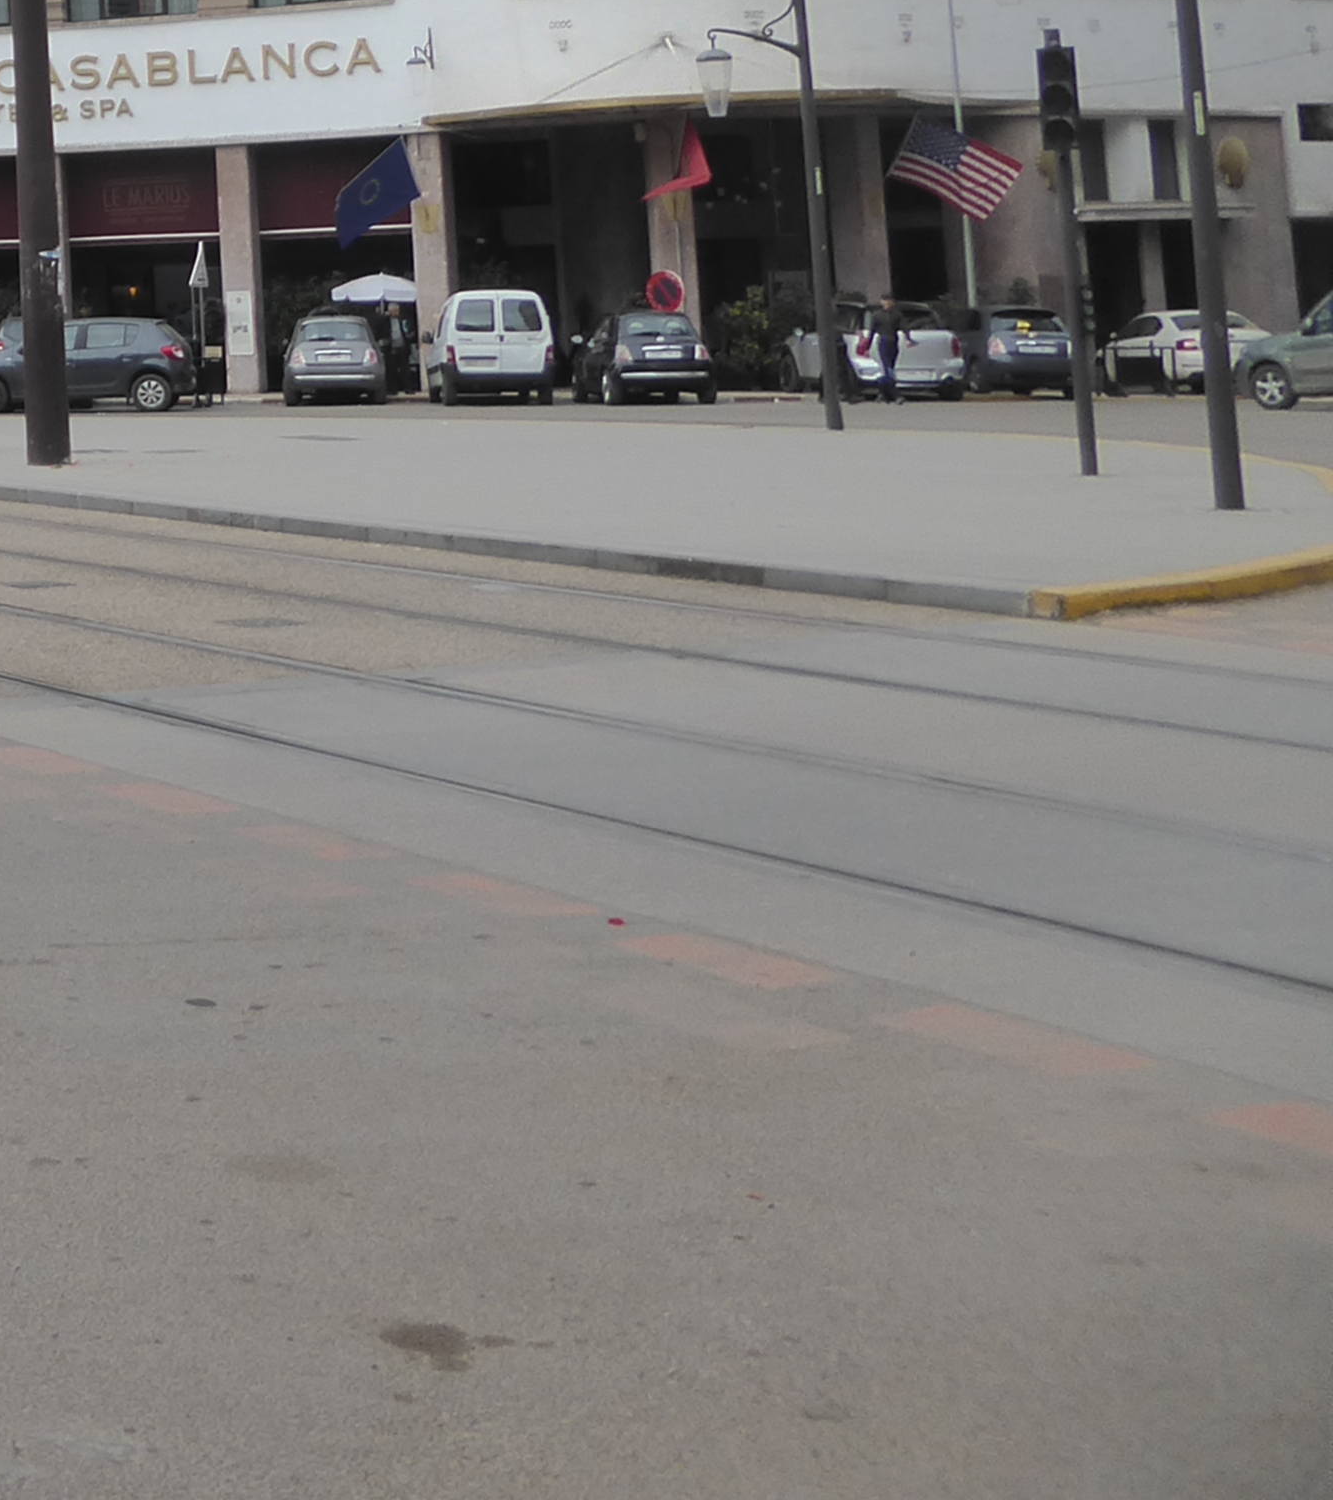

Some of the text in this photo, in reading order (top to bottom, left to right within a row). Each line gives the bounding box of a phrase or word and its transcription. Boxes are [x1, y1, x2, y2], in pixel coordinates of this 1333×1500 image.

[52, 103, 69, 122] &
[79, 98, 134, 120] SPA
[128, 184, 191, 205] MARIUS
